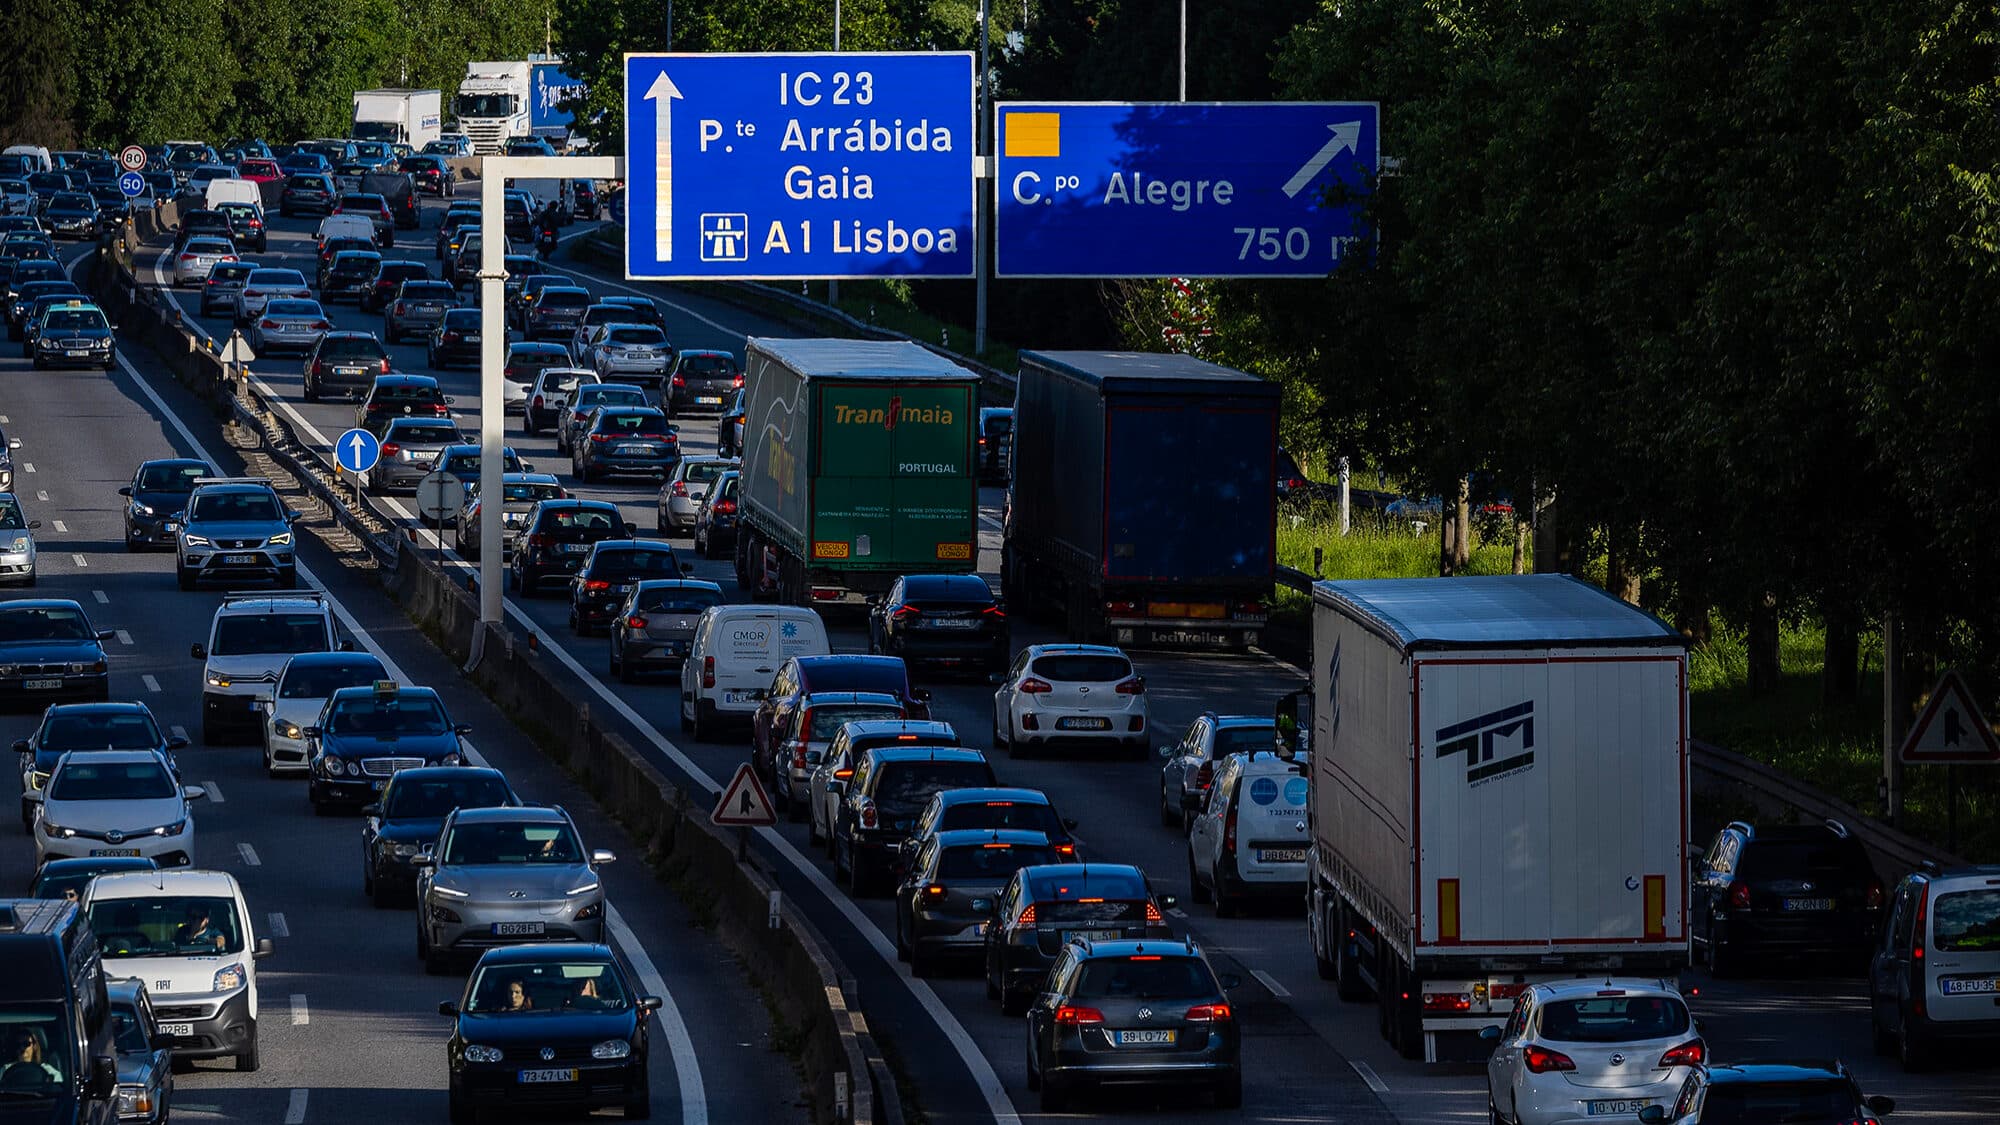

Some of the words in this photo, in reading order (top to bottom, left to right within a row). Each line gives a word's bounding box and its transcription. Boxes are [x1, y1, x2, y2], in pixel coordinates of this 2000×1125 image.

[780, 71, 822, 105] IC
[832, 71, 873, 105] 23
[780, 118, 953, 153] Arrábida
[126, 154, 142, 163] 80
[122, 178, 141, 190] 50
[784, 165, 874, 200] Gaia
[1103, 171, 1234, 211] Alegre
[763, 220, 791, 254] A
[800, 220, 812, 254] 1
[833, 219, 957, 254] Lisboa
[1234, 227, 1309, 261] 750
[899, 463, 958, 474] PORTUGAL
[733, 631, 765, 640] CMOR
[155, 979, 172, 990] FIAT
